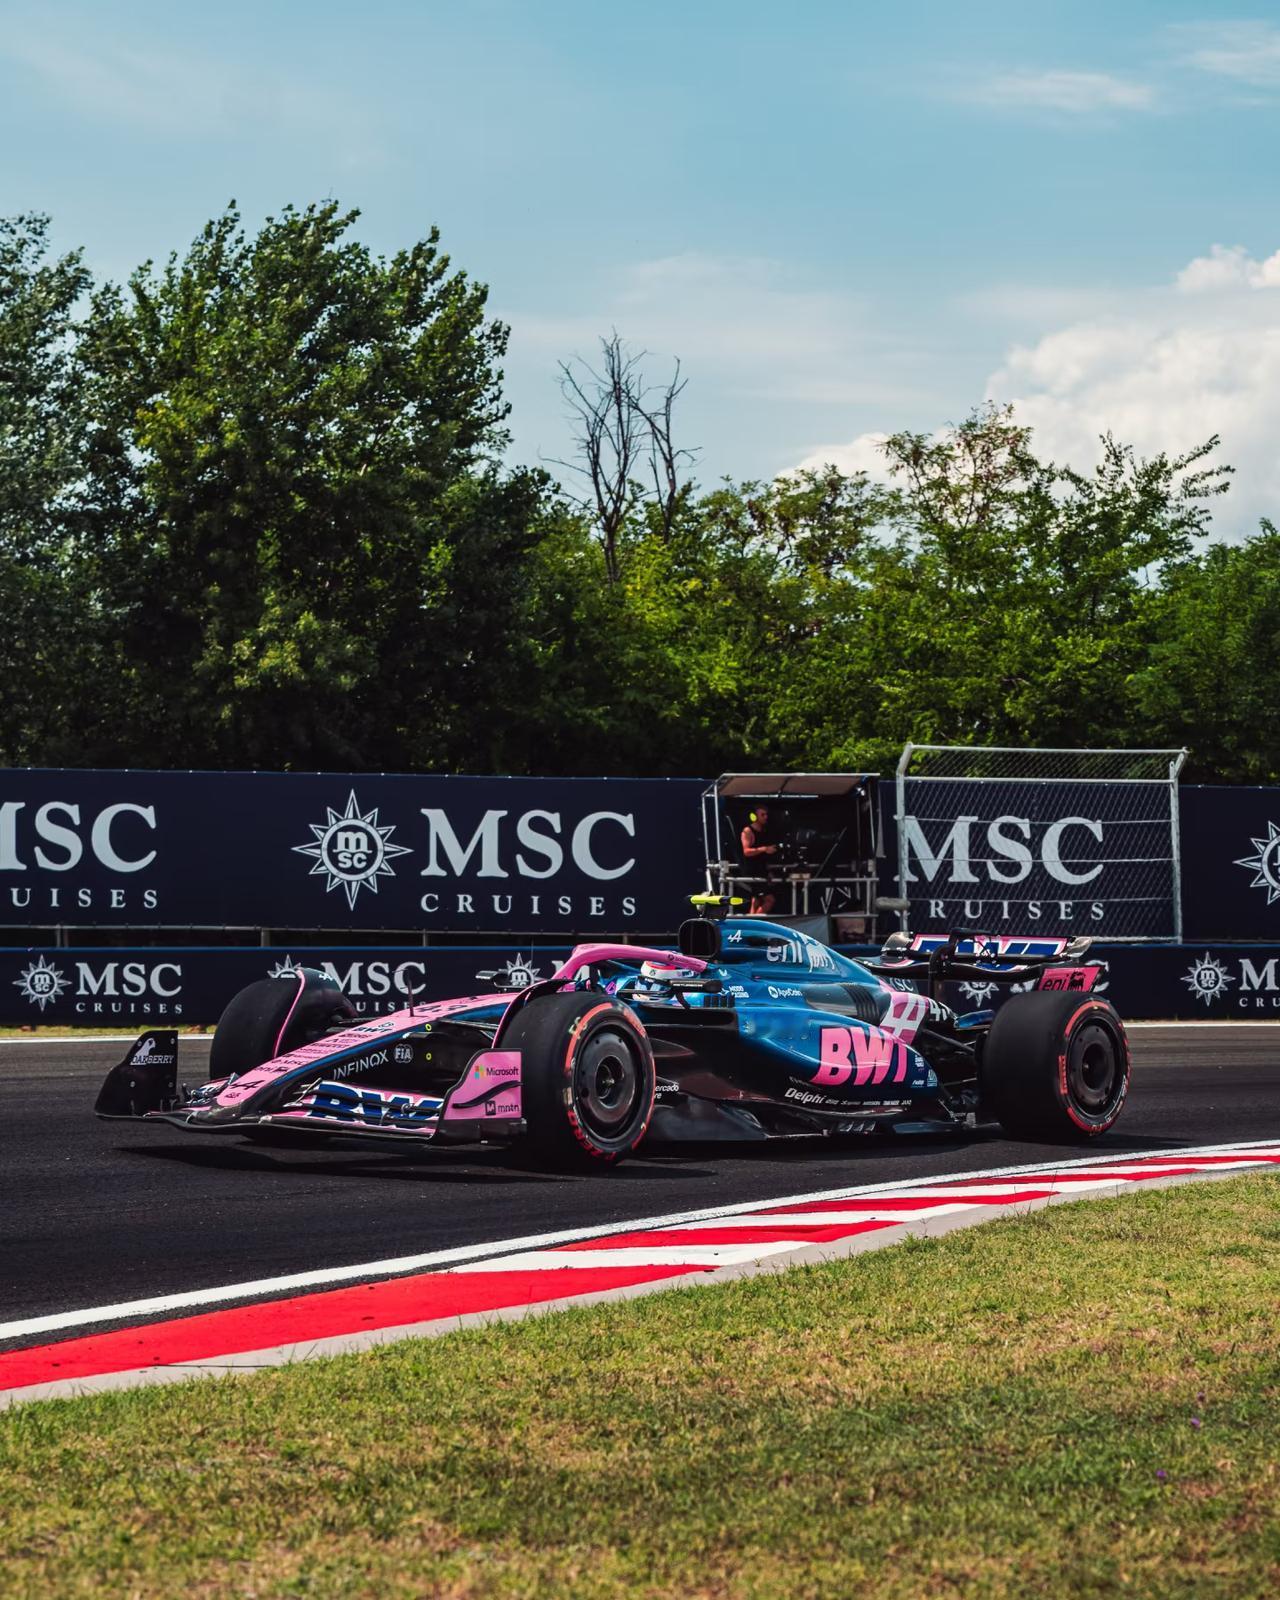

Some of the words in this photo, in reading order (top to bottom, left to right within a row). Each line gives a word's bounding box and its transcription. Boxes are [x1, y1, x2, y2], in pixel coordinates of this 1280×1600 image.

[0, 801, 157, 872] SC
[421, 808, 635, 880] MSC
[893, 815, 1104, 885] MSC
[11, 888, 158, 908] UISES
[421, 893, 636, 916] CRUISES
[76, 962, 182, 996] MSC
[321, 961, 426, 995] MSC
[76, 1002, 182, 1014] CRUISES
[356, 1001, 426, 1013] UISE
[333, 1049, 389, 1080] INFINOX
[395, 1047, 412, 1060] FIA
[812, 1027, 908, 1086] BWT
[486, 1066, 519, 1076] Microsoft
[655, 1082, 679, 1092] ercado
[784, 1087, 826, 1104] Delphi
[310, 1081, 444, 1129] BW
